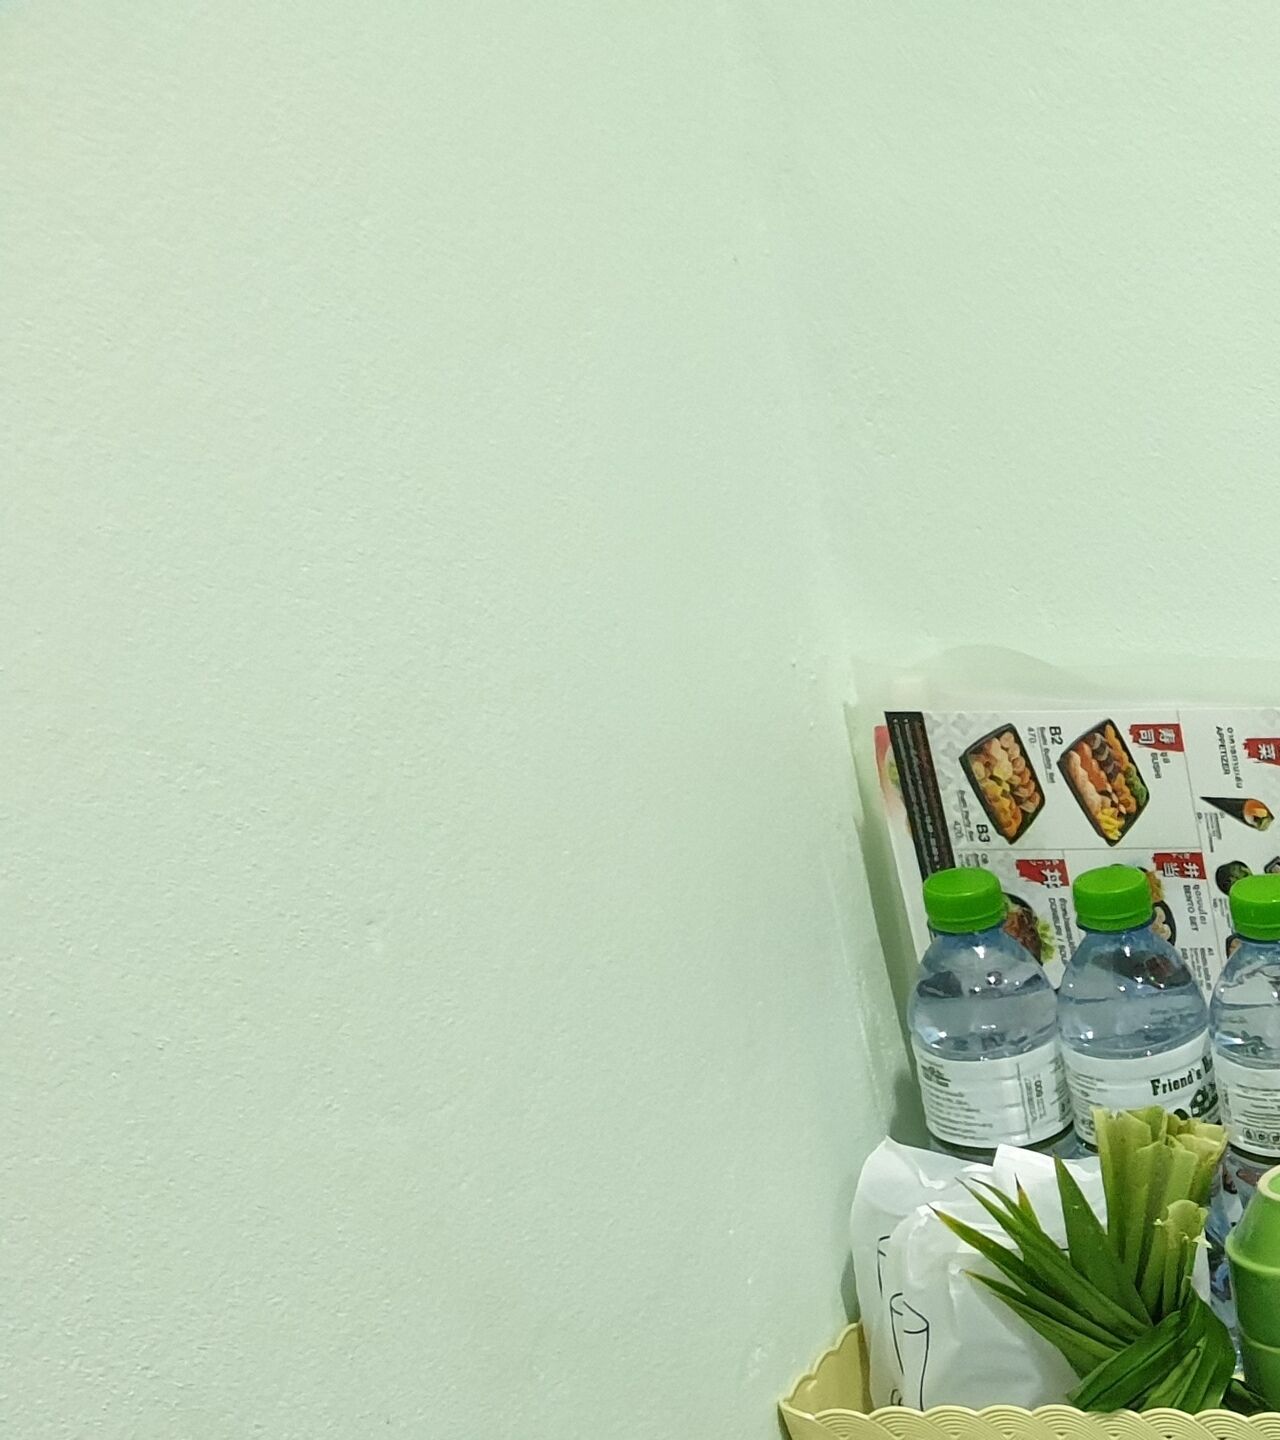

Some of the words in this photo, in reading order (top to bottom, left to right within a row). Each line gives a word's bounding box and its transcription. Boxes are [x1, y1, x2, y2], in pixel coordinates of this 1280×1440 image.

[1049, 726, 1063, 745] B2
[1216, 726, 1231, 776] APPETIZER
[976, 823, 991, 843] B3
[1183, 884, 1195, 914] BENTO
[1150, 1067, 1203, 1097] Friend's
